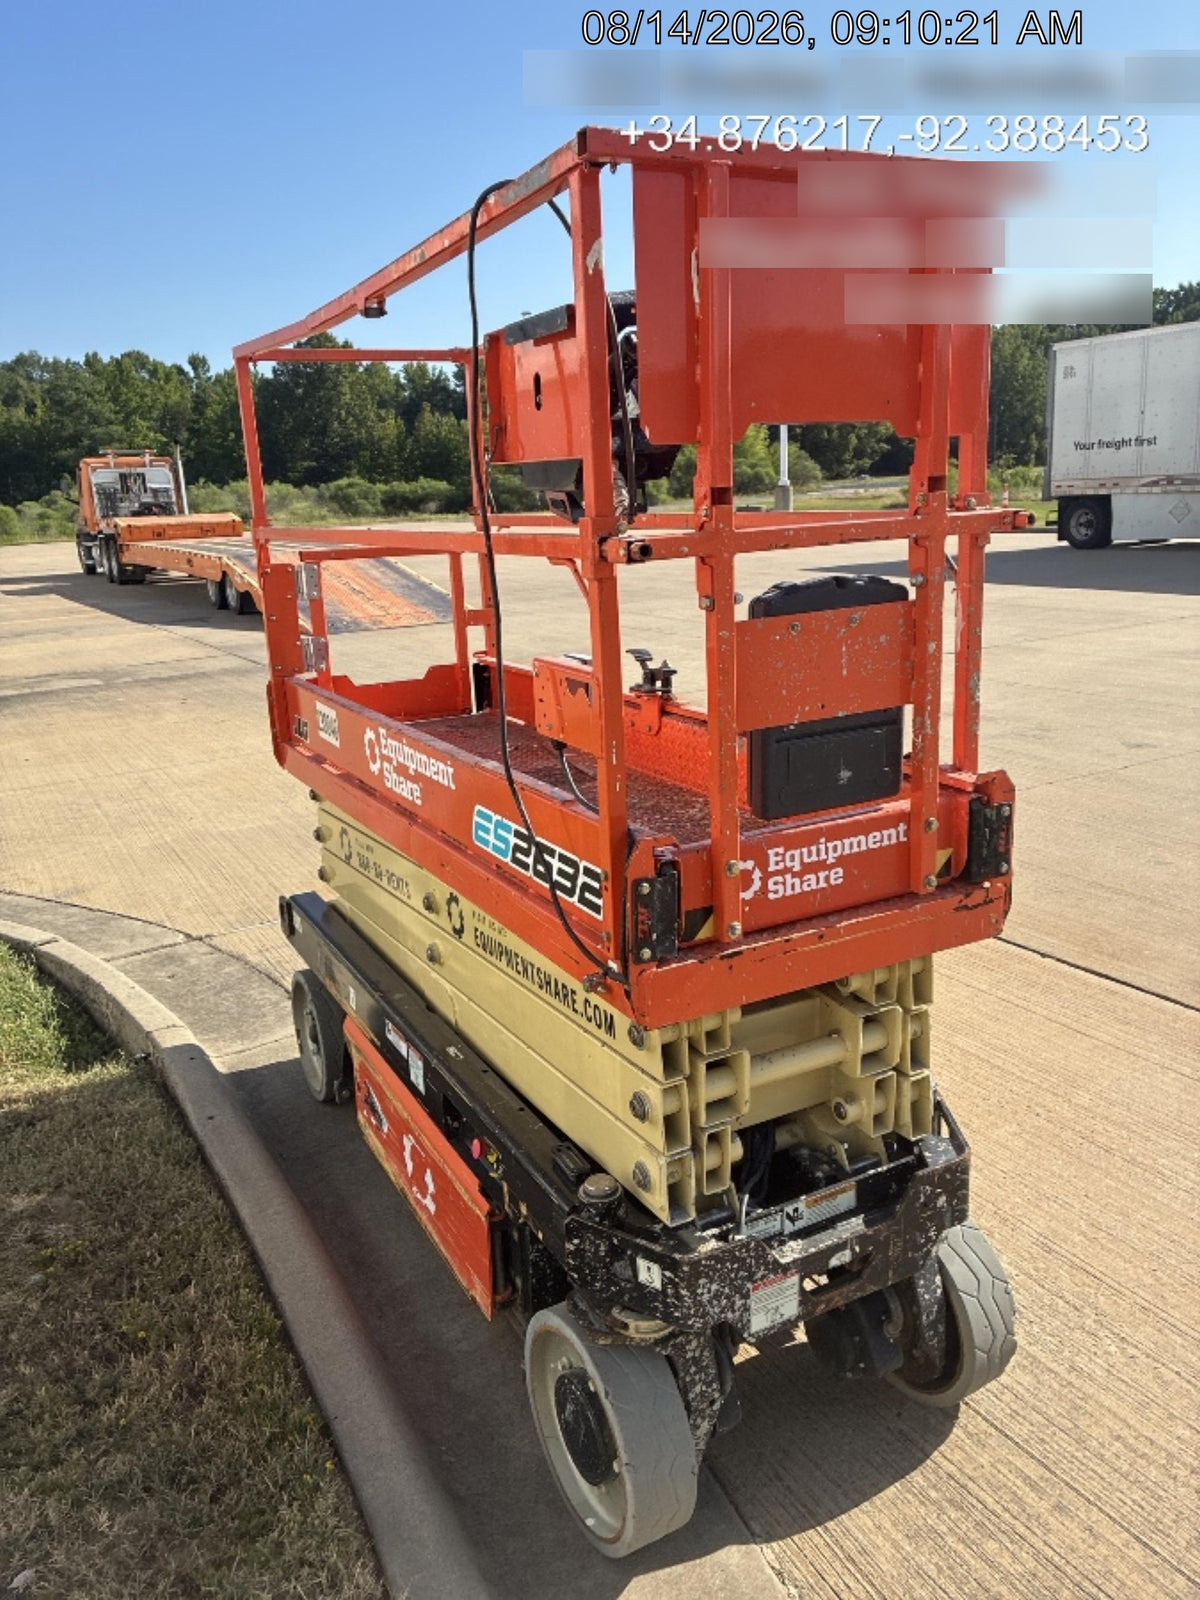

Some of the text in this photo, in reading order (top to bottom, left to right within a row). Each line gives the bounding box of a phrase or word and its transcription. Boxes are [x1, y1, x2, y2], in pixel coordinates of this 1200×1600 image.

[1074, 435, 1157, 452] Your freight first
[378, 726, 456, 791] Equipment
[383, 760, 422, 806] Share
[473, 805, 604, 918] ES2632
[767, 822, 909, 872] Equipment
[767, 866, 845, 901] Share
[473, 926, 617, 1041] EQUIPMENTSHARE.COM
